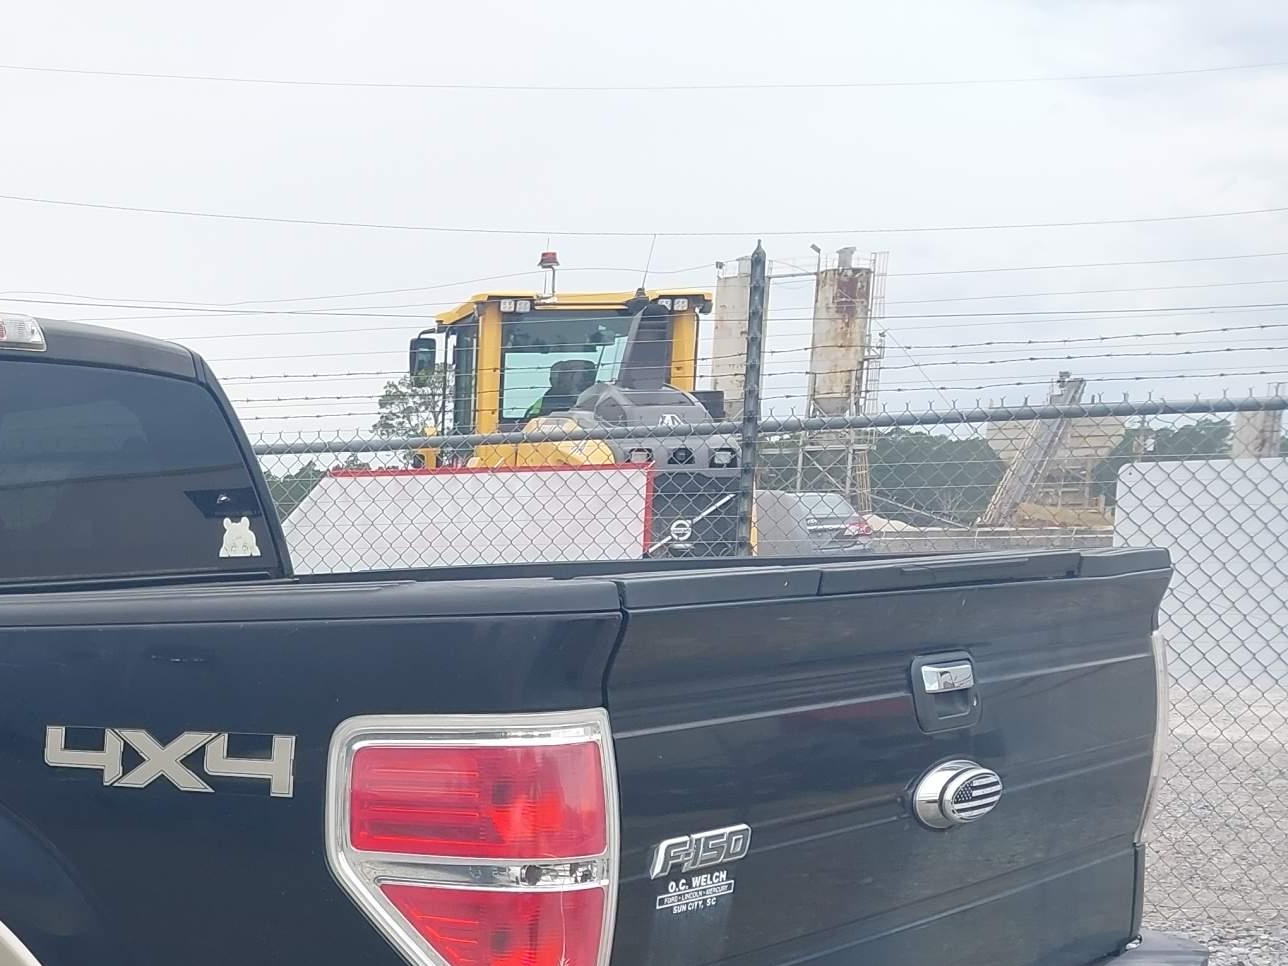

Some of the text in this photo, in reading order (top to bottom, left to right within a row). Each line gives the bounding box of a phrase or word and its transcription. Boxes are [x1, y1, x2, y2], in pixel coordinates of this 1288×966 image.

[668, 870, 727, 893] O.C. WELCH
[673, 903, 687, 914] SUN
[706, 897, 717, 907] SC
